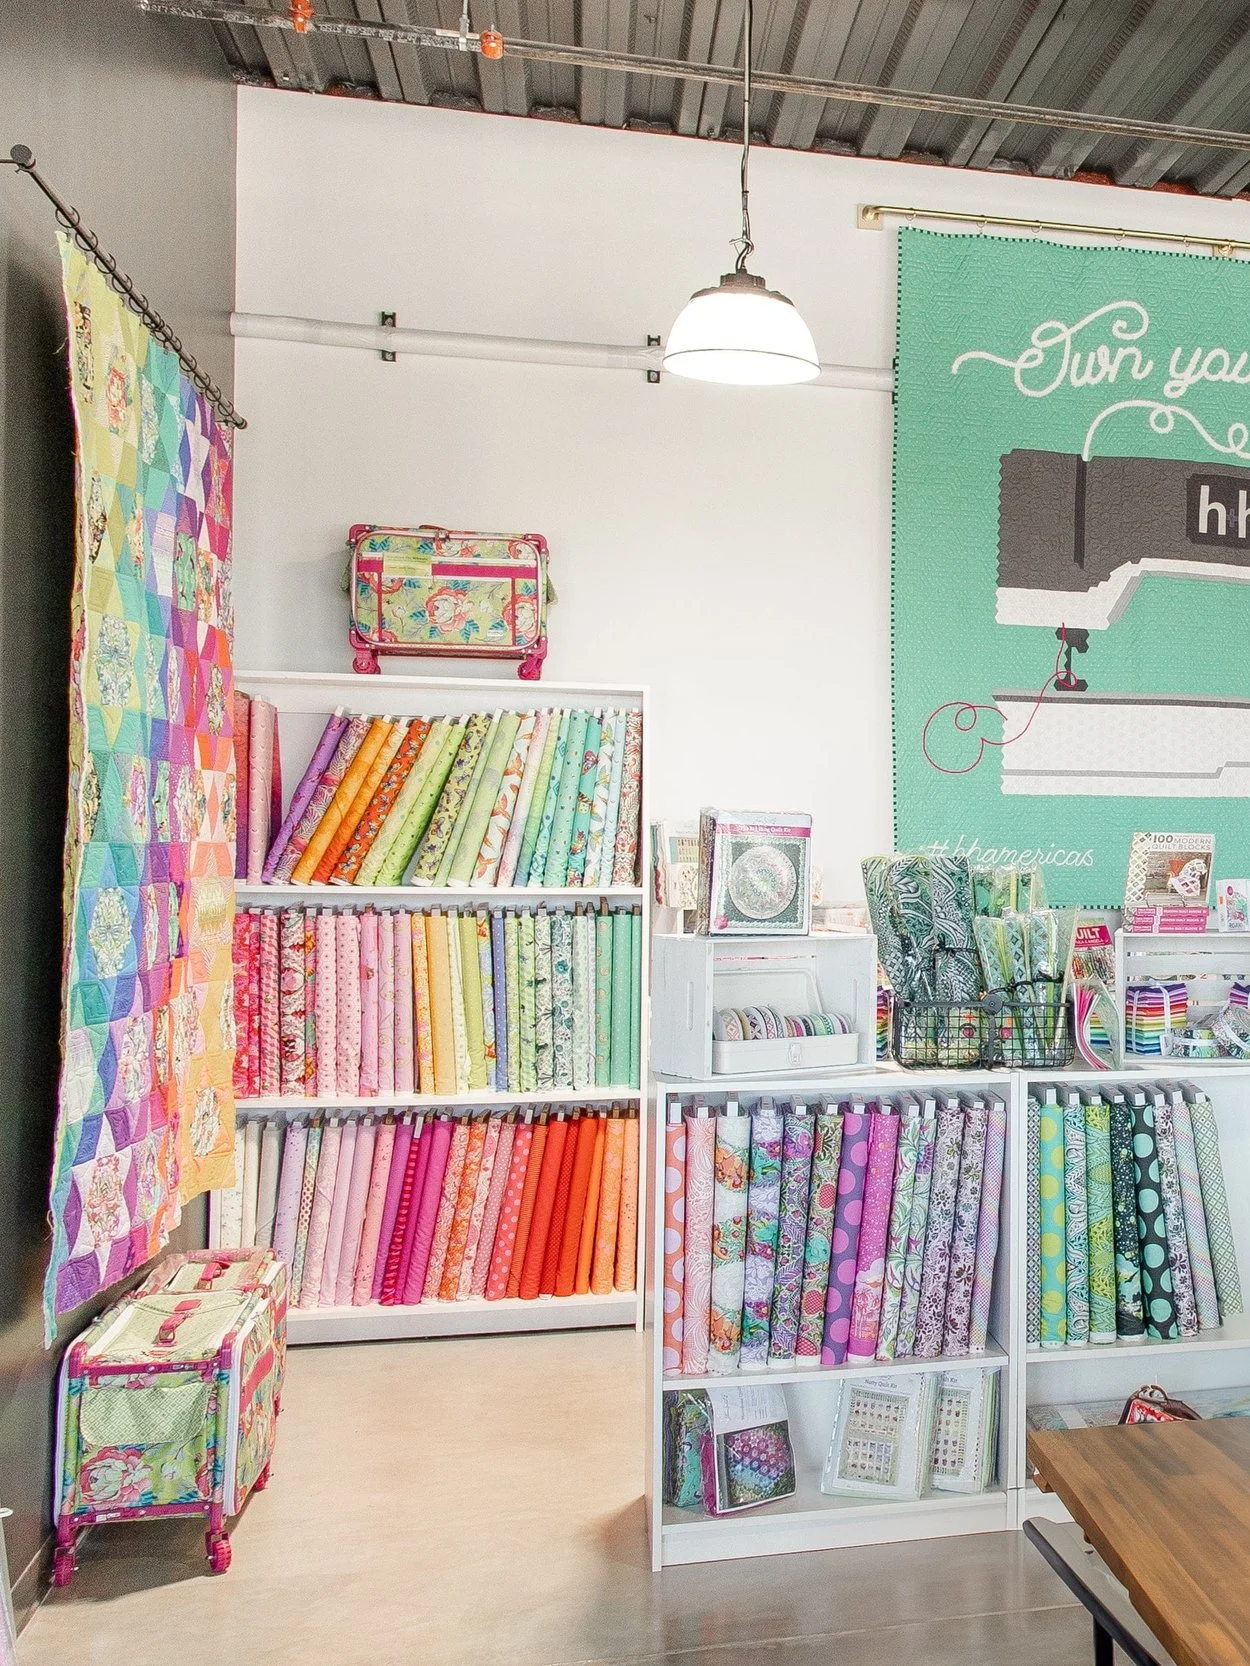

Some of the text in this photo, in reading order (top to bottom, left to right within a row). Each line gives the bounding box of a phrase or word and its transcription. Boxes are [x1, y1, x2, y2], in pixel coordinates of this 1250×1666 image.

[1012, 299, 1154, 398] Own
[1152, 834, 1174, 844] 100
[1173, 837, 1212, 845] MODERN
[1076, 927, 1100, 940] UILT
